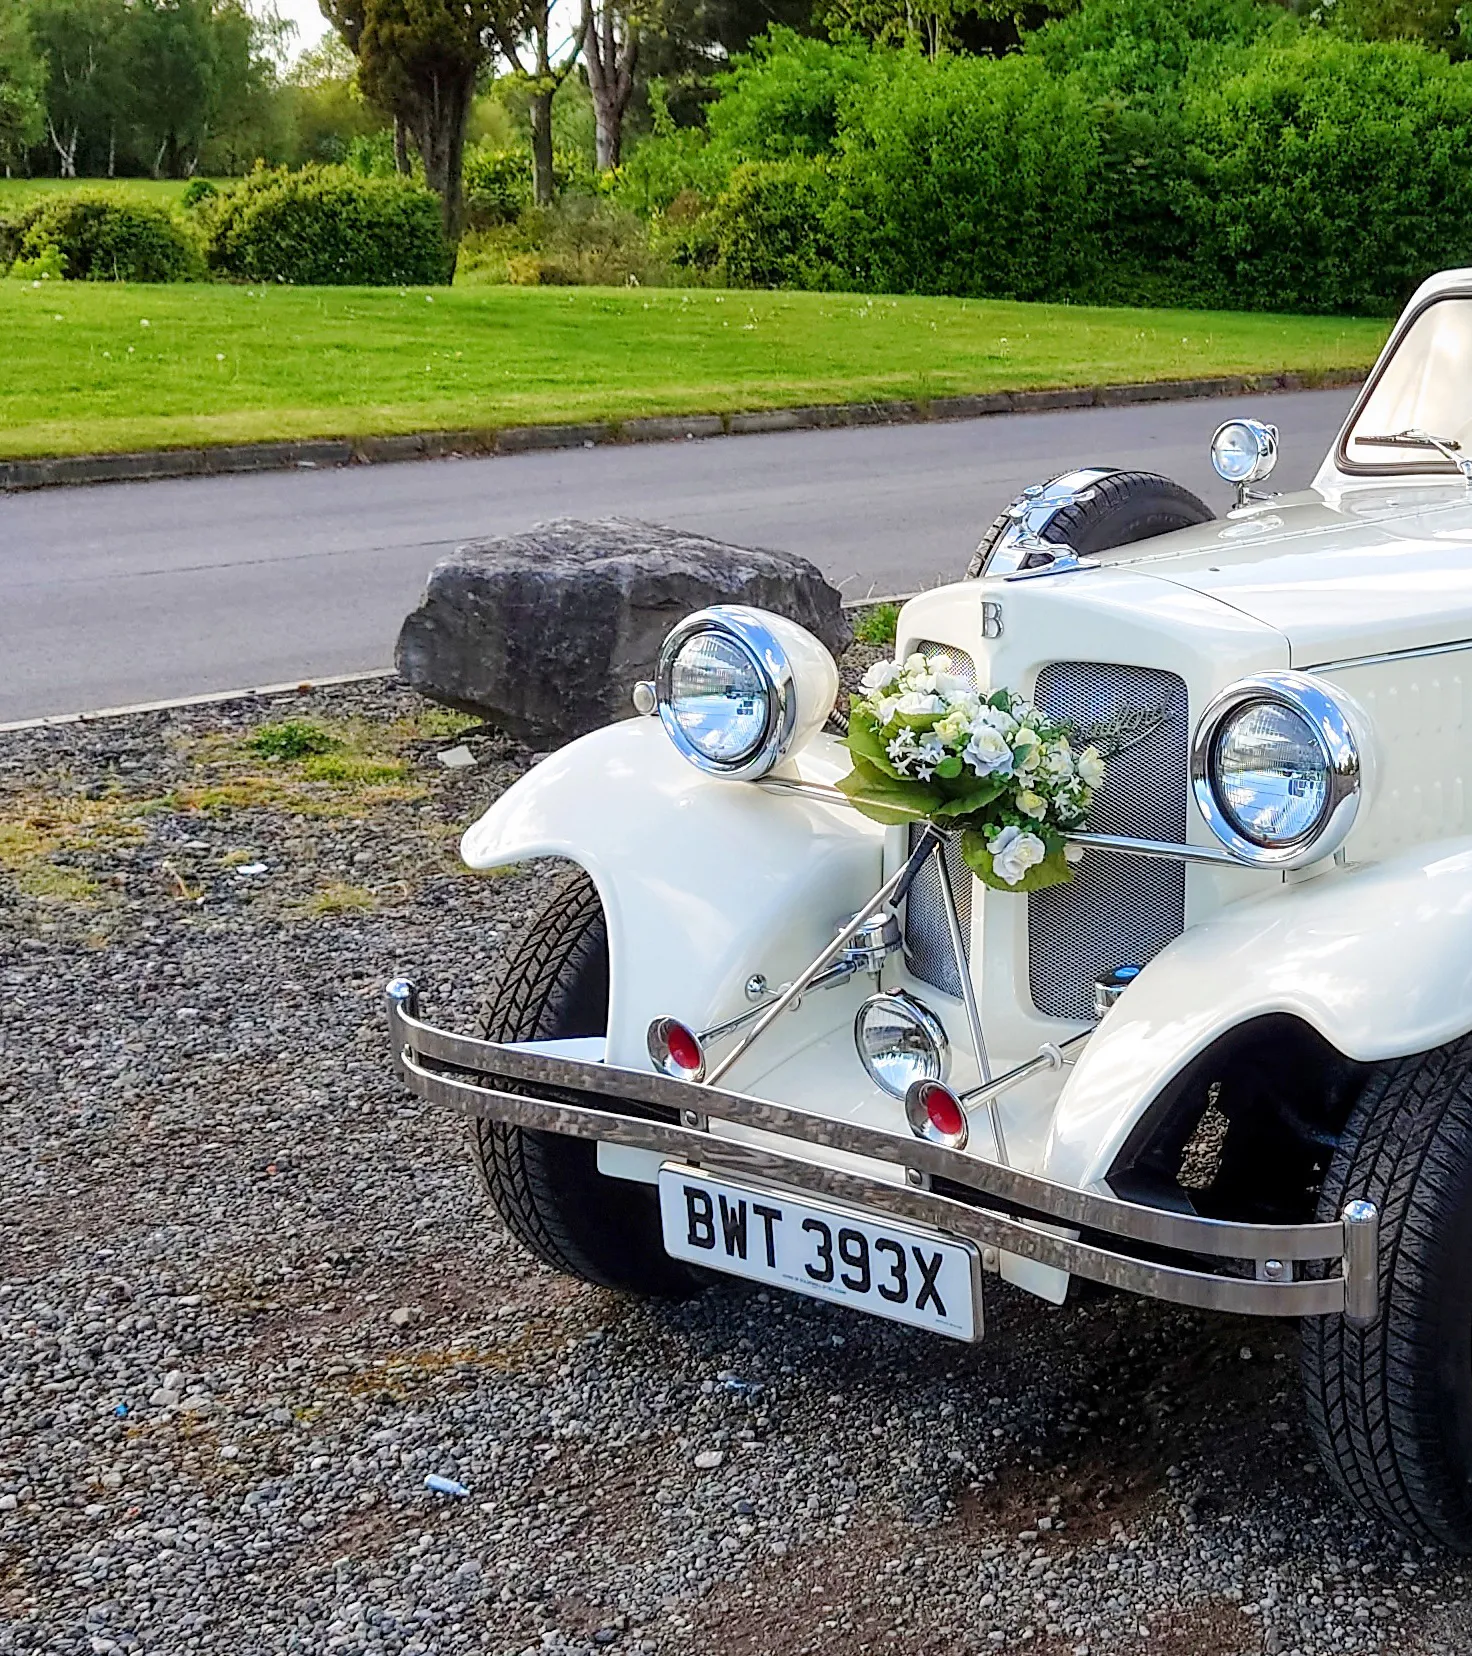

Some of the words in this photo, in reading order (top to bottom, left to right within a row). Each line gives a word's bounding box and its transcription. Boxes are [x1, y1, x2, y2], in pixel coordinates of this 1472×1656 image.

[980, 601, 1004, 639] B
[683, 1184, 784, 1270] BWT
[801, 1217, 948, 1318] 393X
